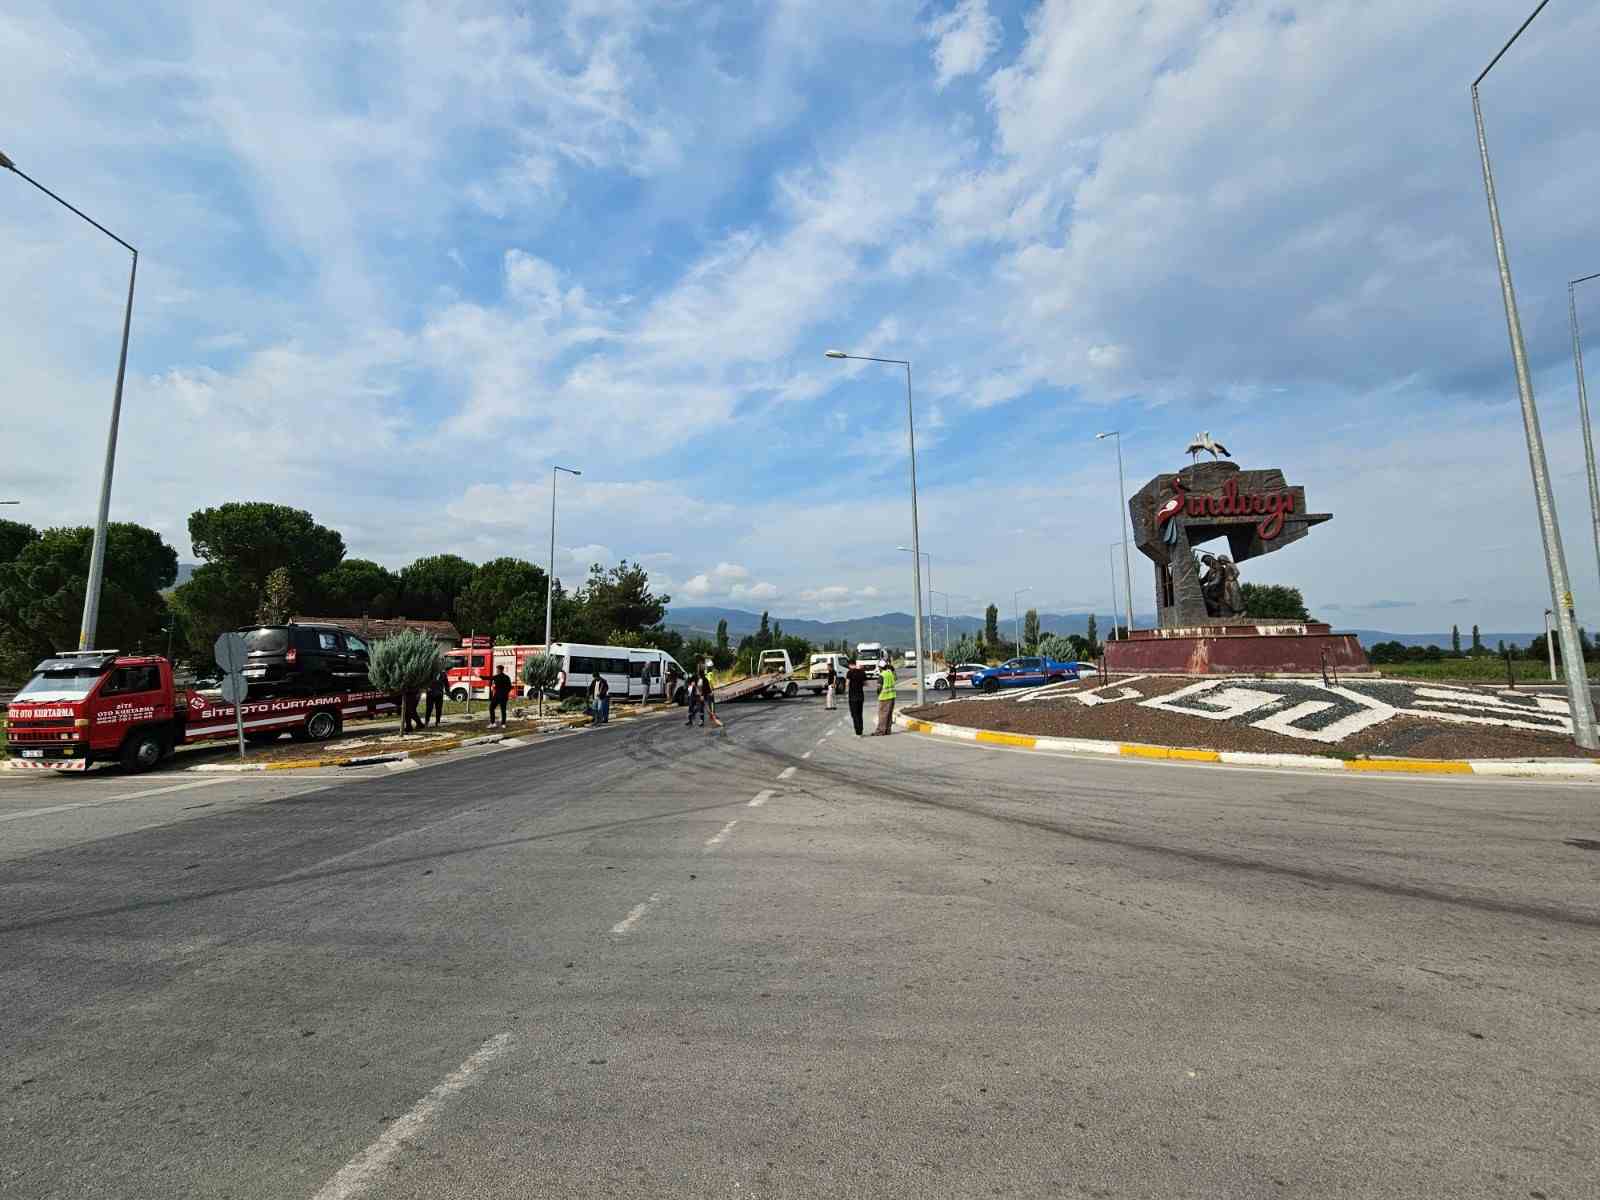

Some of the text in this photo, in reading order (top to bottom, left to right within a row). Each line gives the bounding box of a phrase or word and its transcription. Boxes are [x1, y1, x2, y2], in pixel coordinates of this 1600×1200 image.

[33, 708, 74, 718] KURTARMA
[202, 708, 235, 718] SİTE
[272, 697, 341, 710] KURTARMA
